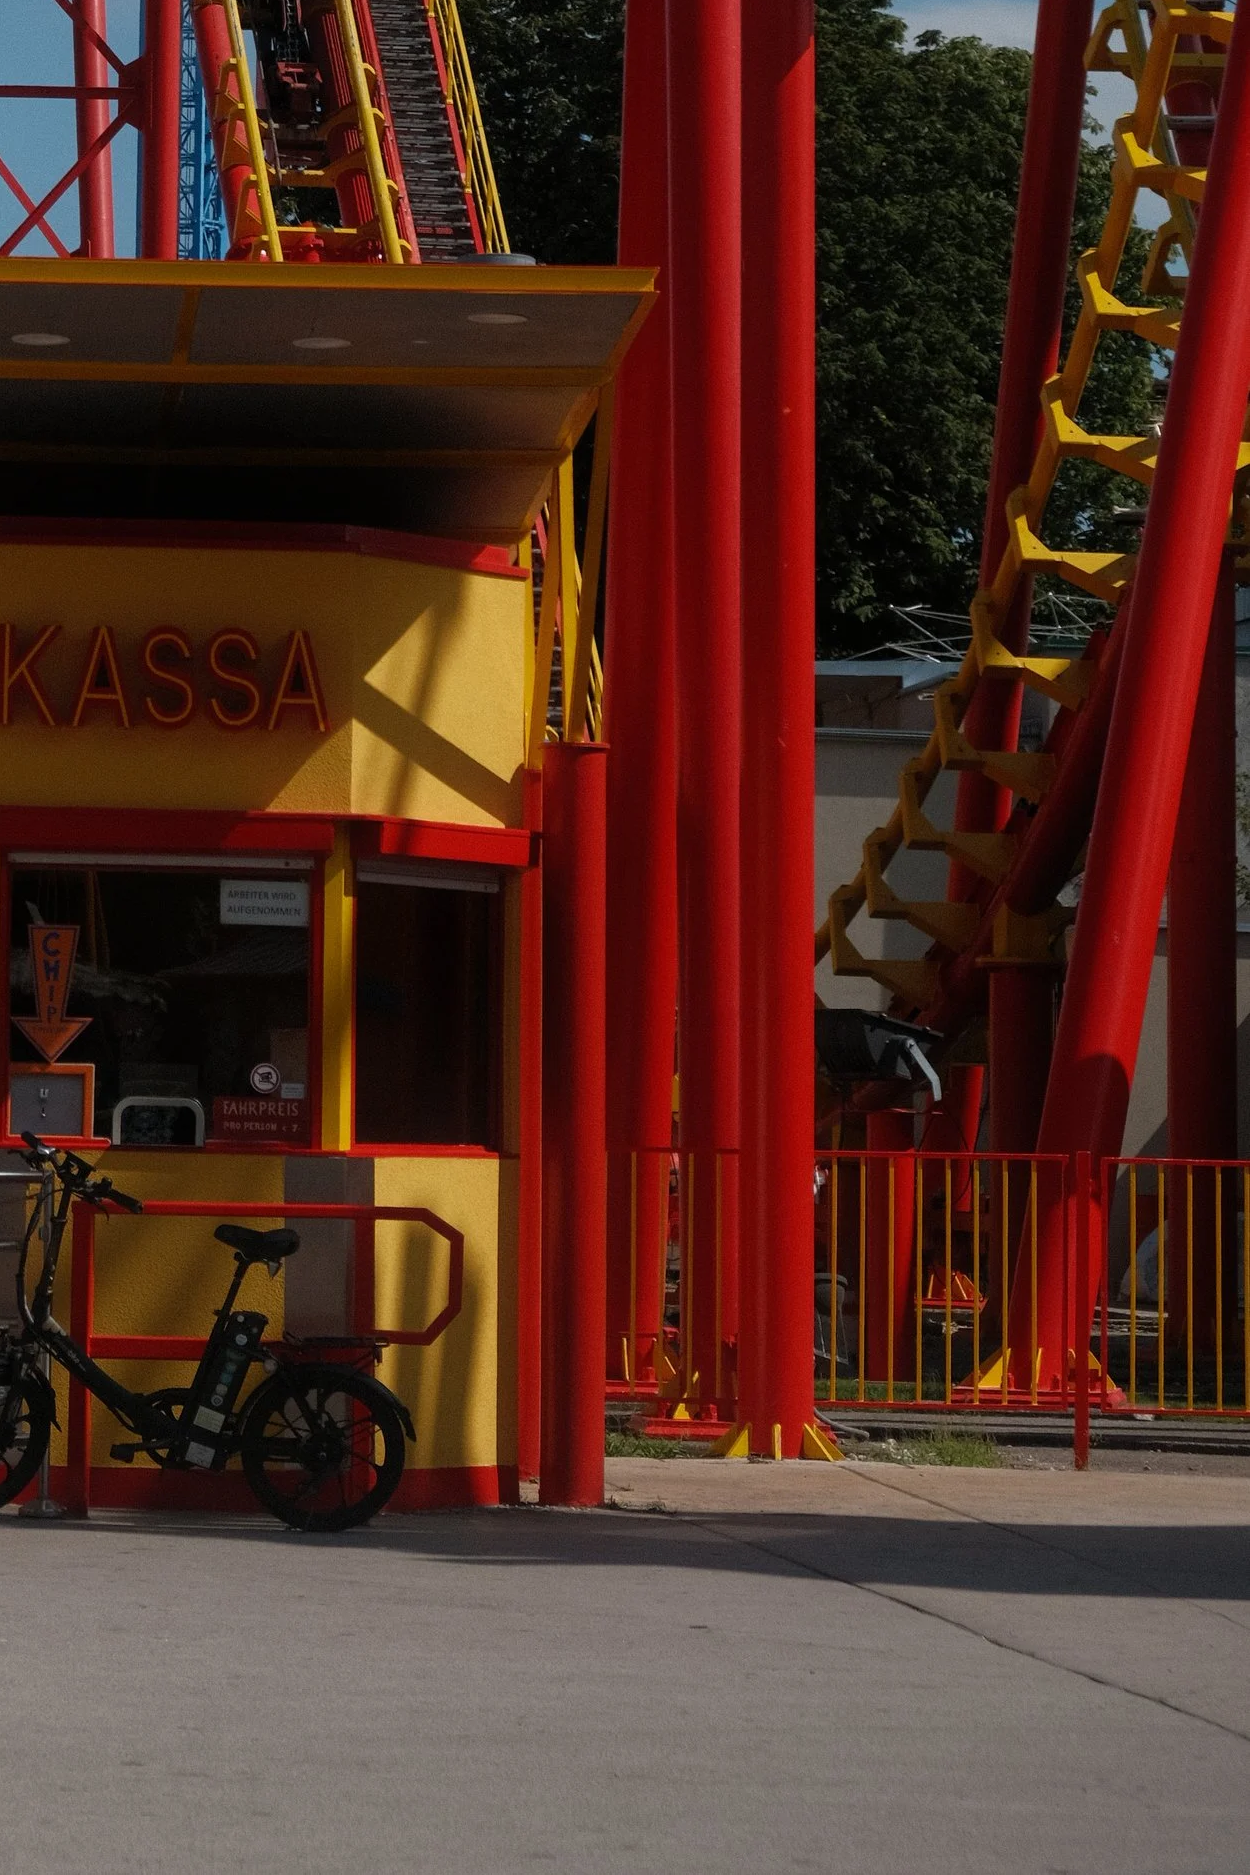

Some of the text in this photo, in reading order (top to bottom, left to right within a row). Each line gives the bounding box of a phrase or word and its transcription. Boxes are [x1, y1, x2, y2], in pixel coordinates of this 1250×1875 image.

[228, 889, 296, 902] ARBEITER WIRD
[227, 905, 302, 917] AUFGENOMMEN
[223, 1100, 299, 1117] FAHRPREIS
[223, 1121, 241, 1131] PRO
[244, 1121, 277, 1132] PERSON
